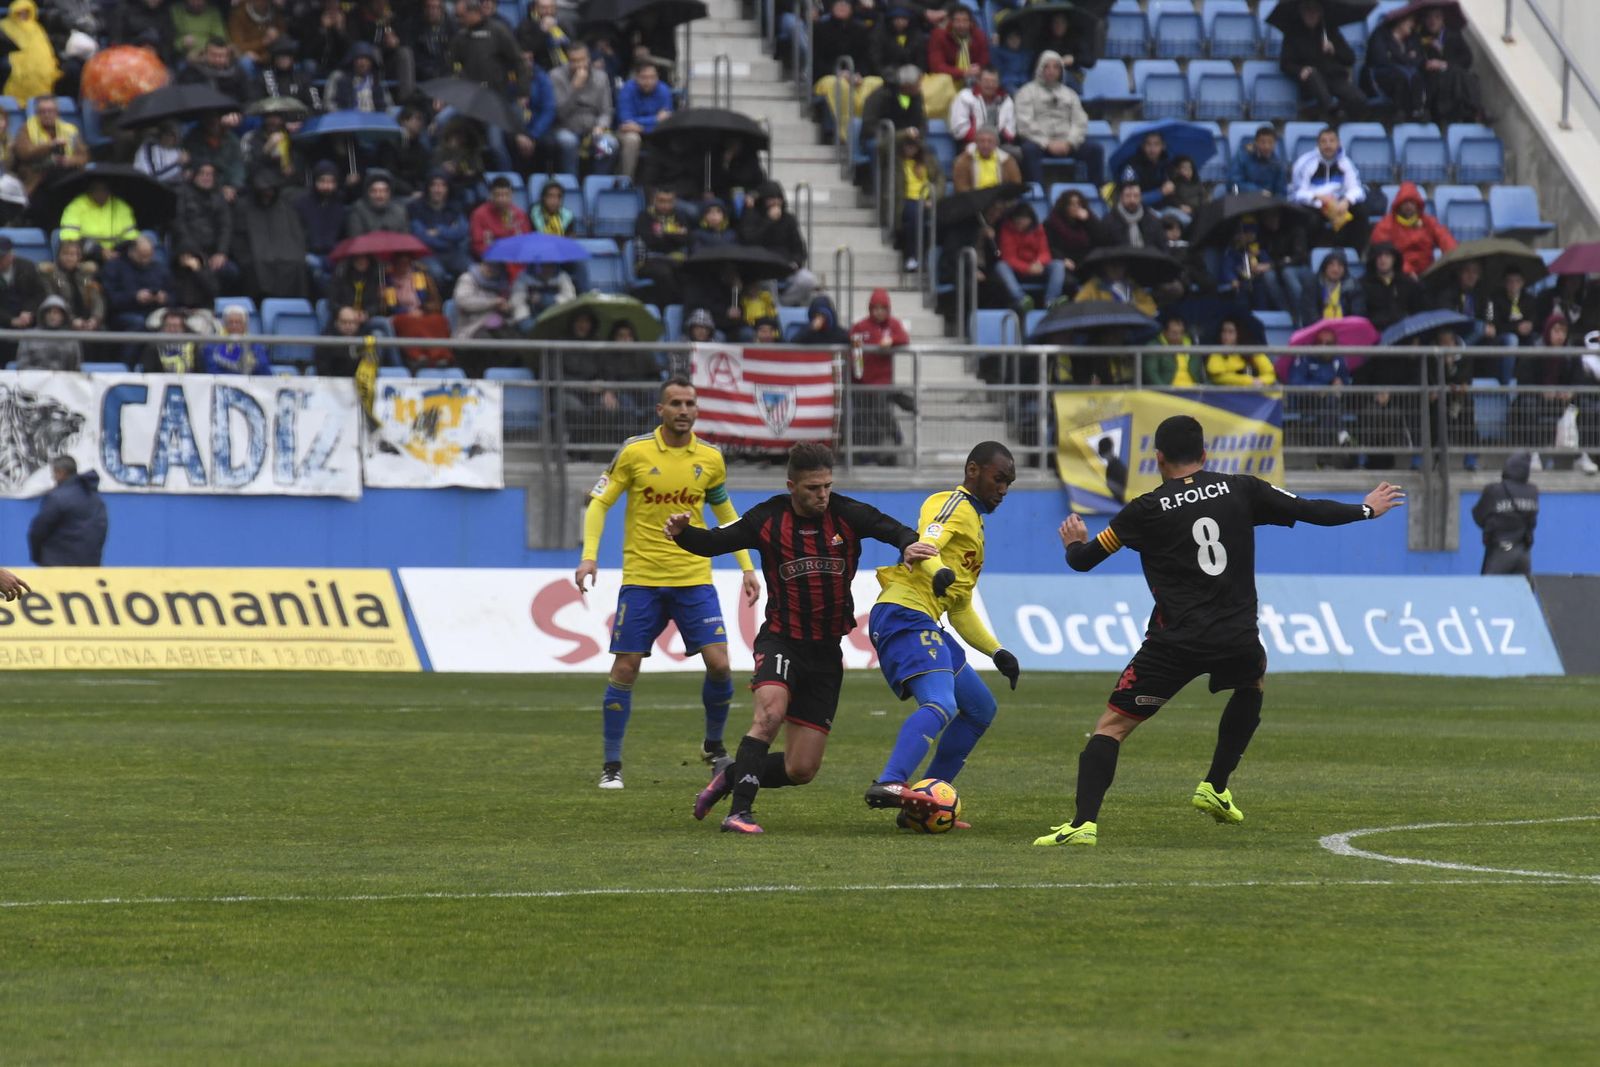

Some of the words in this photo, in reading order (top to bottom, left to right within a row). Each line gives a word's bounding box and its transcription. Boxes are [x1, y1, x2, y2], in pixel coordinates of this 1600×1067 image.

[1160, 481, 1230, 511] R.FOLCH
[1192, 517, 1227, 576] 8
[786, 560, 840, 575] BORGES
[1016, 601, 1354, 656] Occital
[1364, 602, 1526, 656] Cádiz
[63, 647, 154, 666] COCINA
[165, 647, 265, 666] ABIERTA
[775, 653, 791, 681] 11
